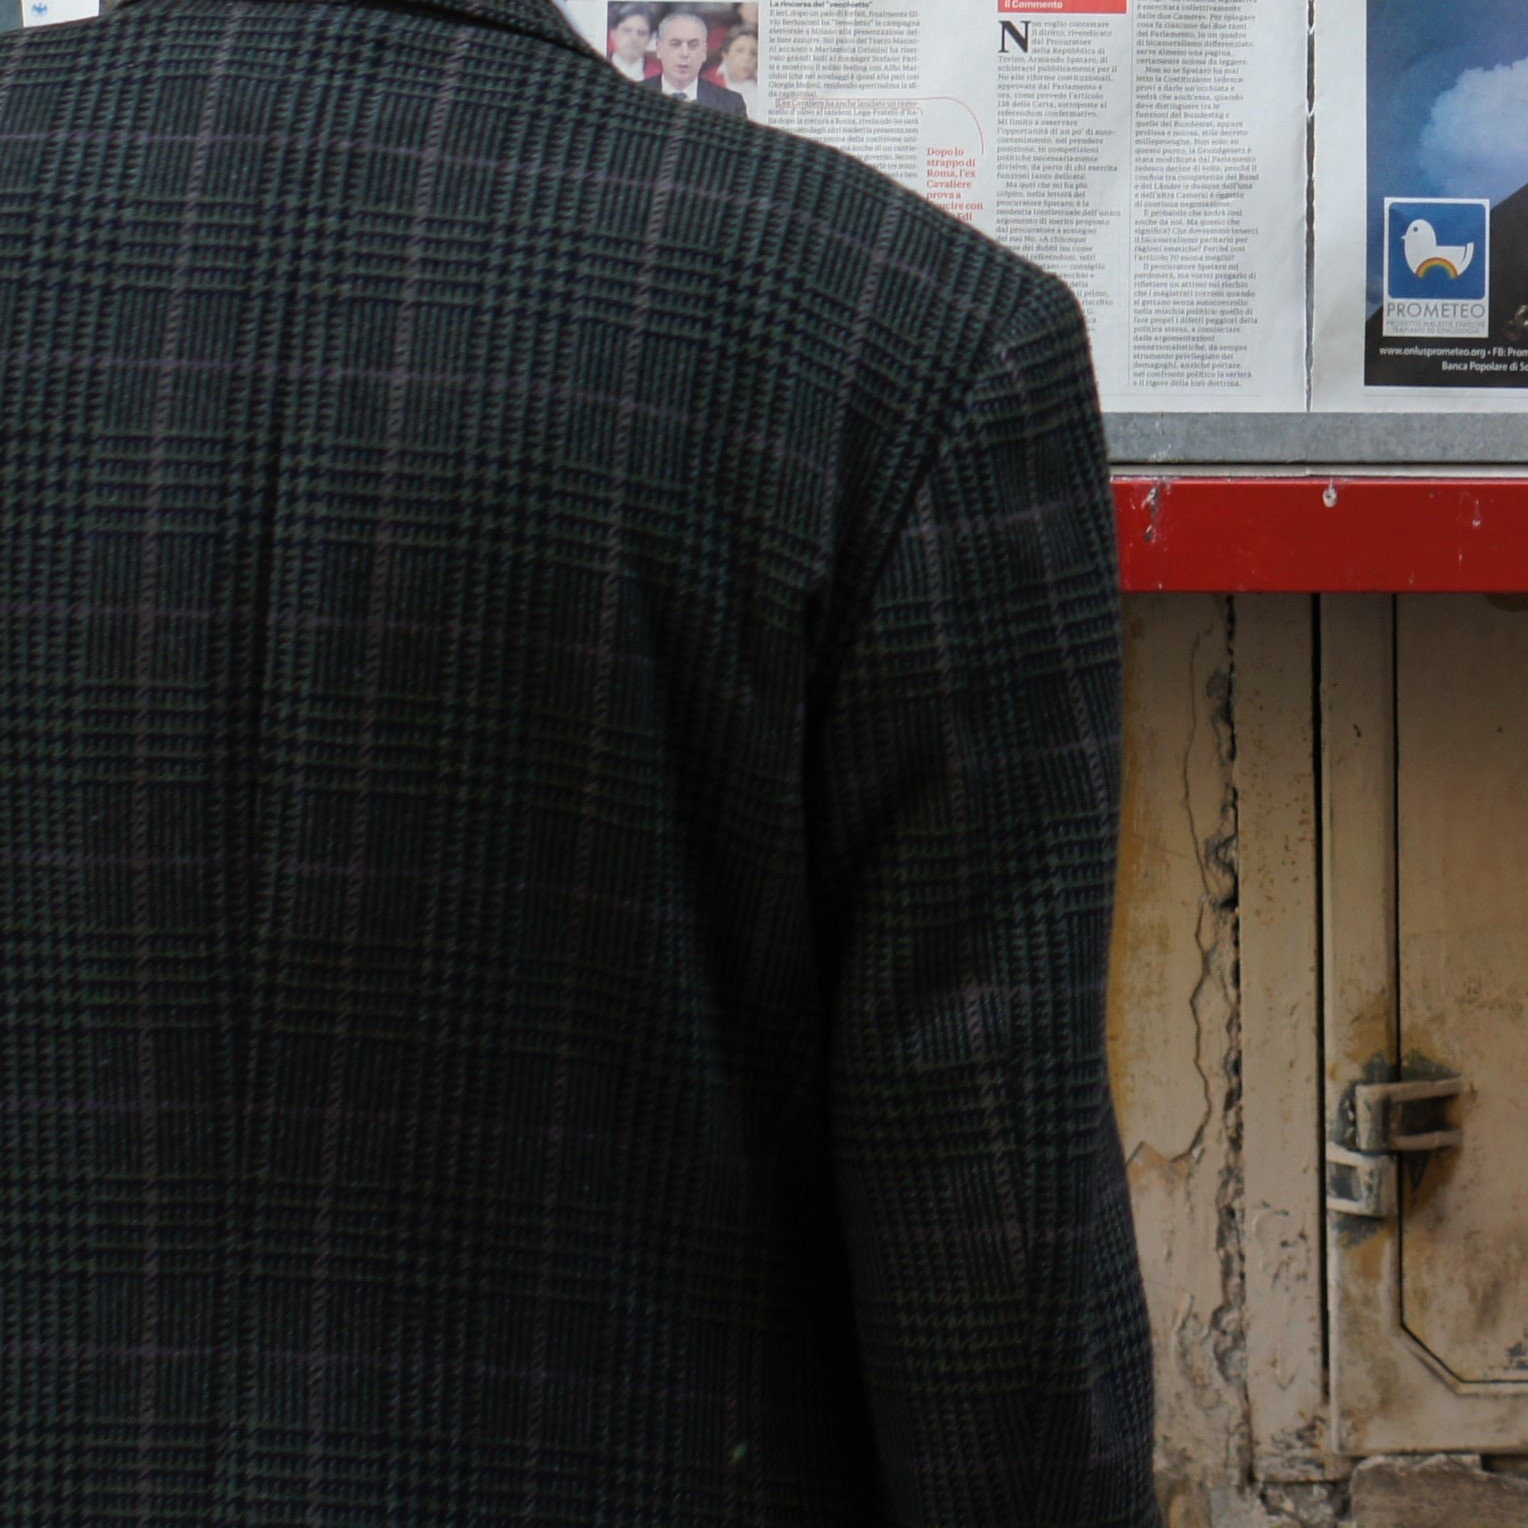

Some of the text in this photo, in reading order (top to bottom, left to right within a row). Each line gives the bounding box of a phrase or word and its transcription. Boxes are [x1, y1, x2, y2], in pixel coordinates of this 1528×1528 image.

[1004, 0, 1063, 9] Il Commento
[1386, 302, 1485, 320] PROMETEO
